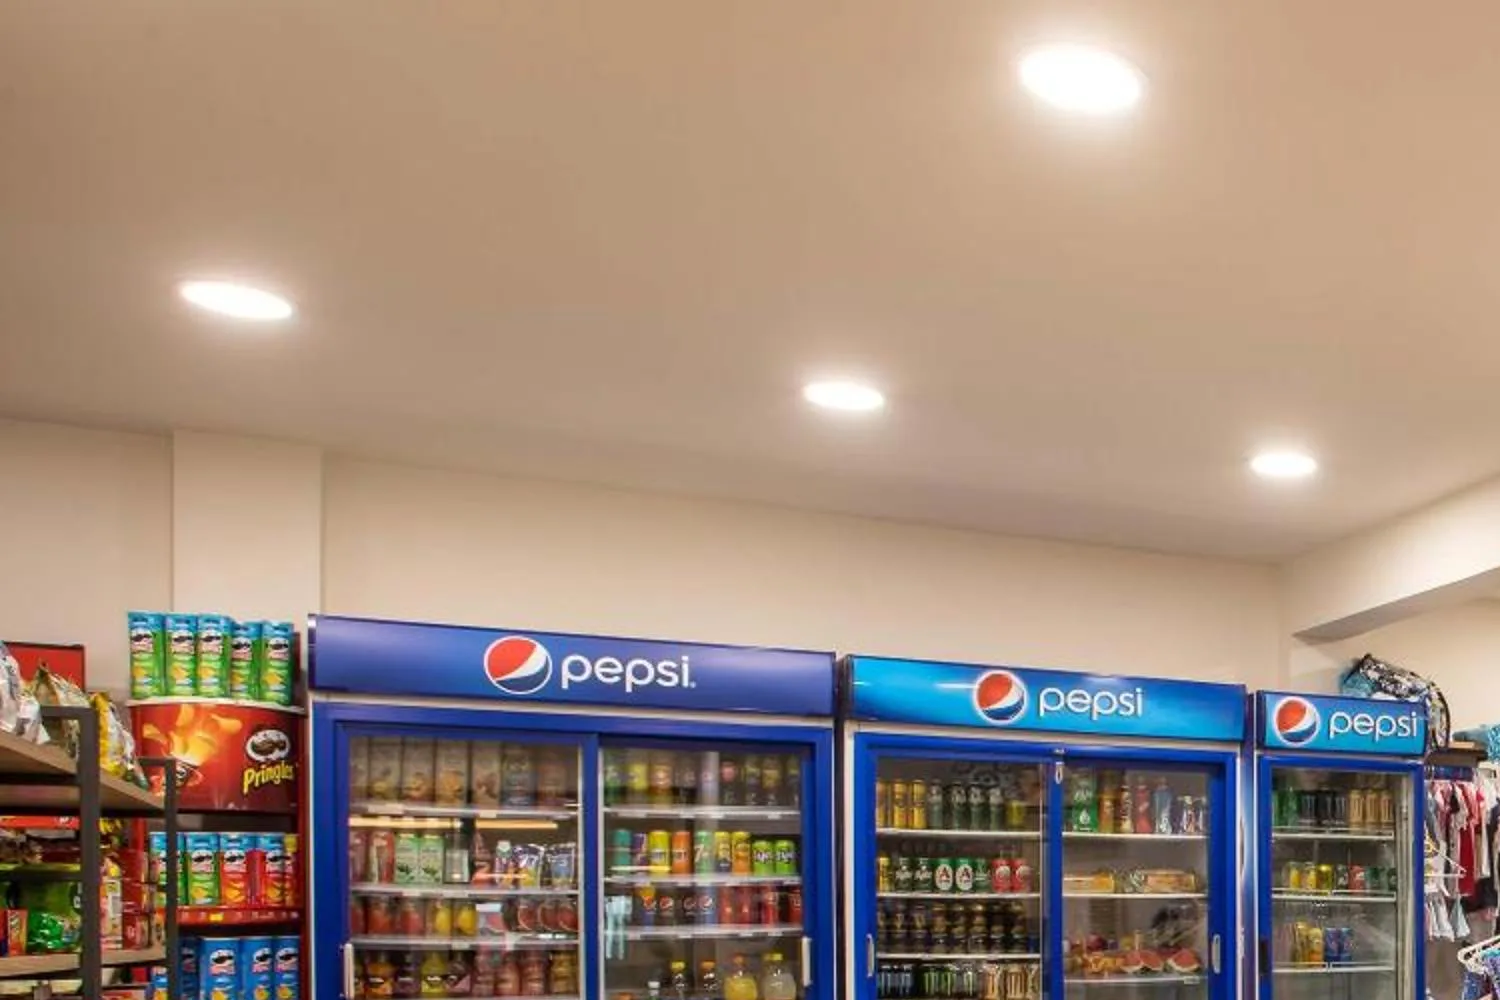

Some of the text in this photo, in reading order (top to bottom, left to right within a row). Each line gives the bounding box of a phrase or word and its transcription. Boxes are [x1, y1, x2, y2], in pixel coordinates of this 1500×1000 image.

[561, 654, 693, 693] pepsi
[1038, 686, 1144, 720] pepsi
[1329, 710, 1419, 742] pepsi
[243, 761, 295, 795] Pringles
